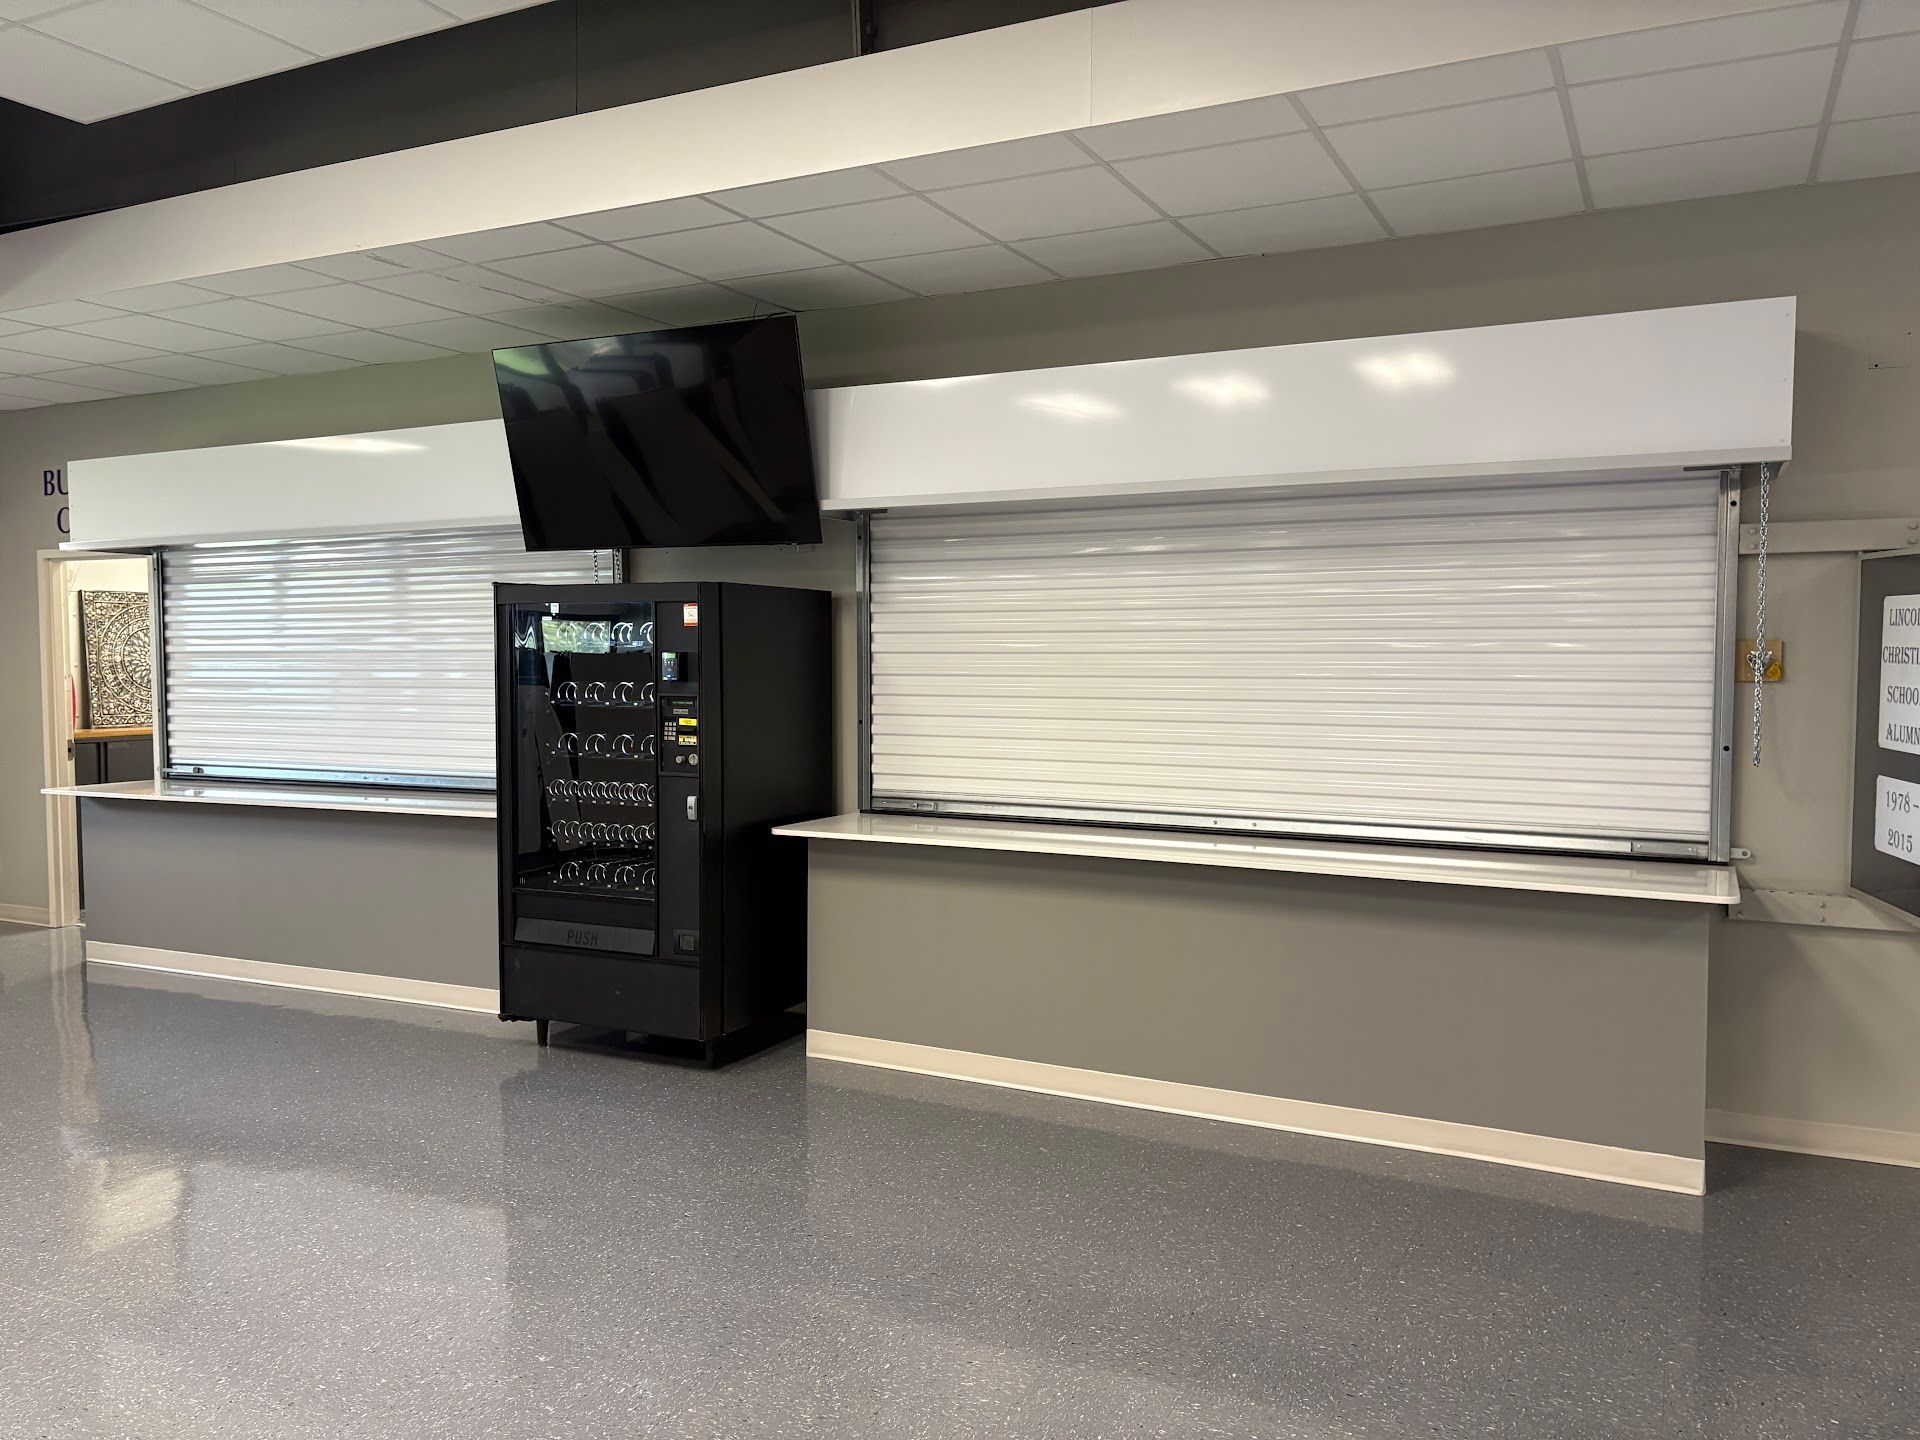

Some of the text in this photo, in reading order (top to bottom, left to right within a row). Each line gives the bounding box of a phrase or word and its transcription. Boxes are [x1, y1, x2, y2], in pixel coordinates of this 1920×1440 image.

[1887, 685, 1920, 705] SCHOO
[1886, 790, 1910, 813] 1978
[1888, 828, 1913, 853] 2015
[567, 929, 599, 947] PUSH
